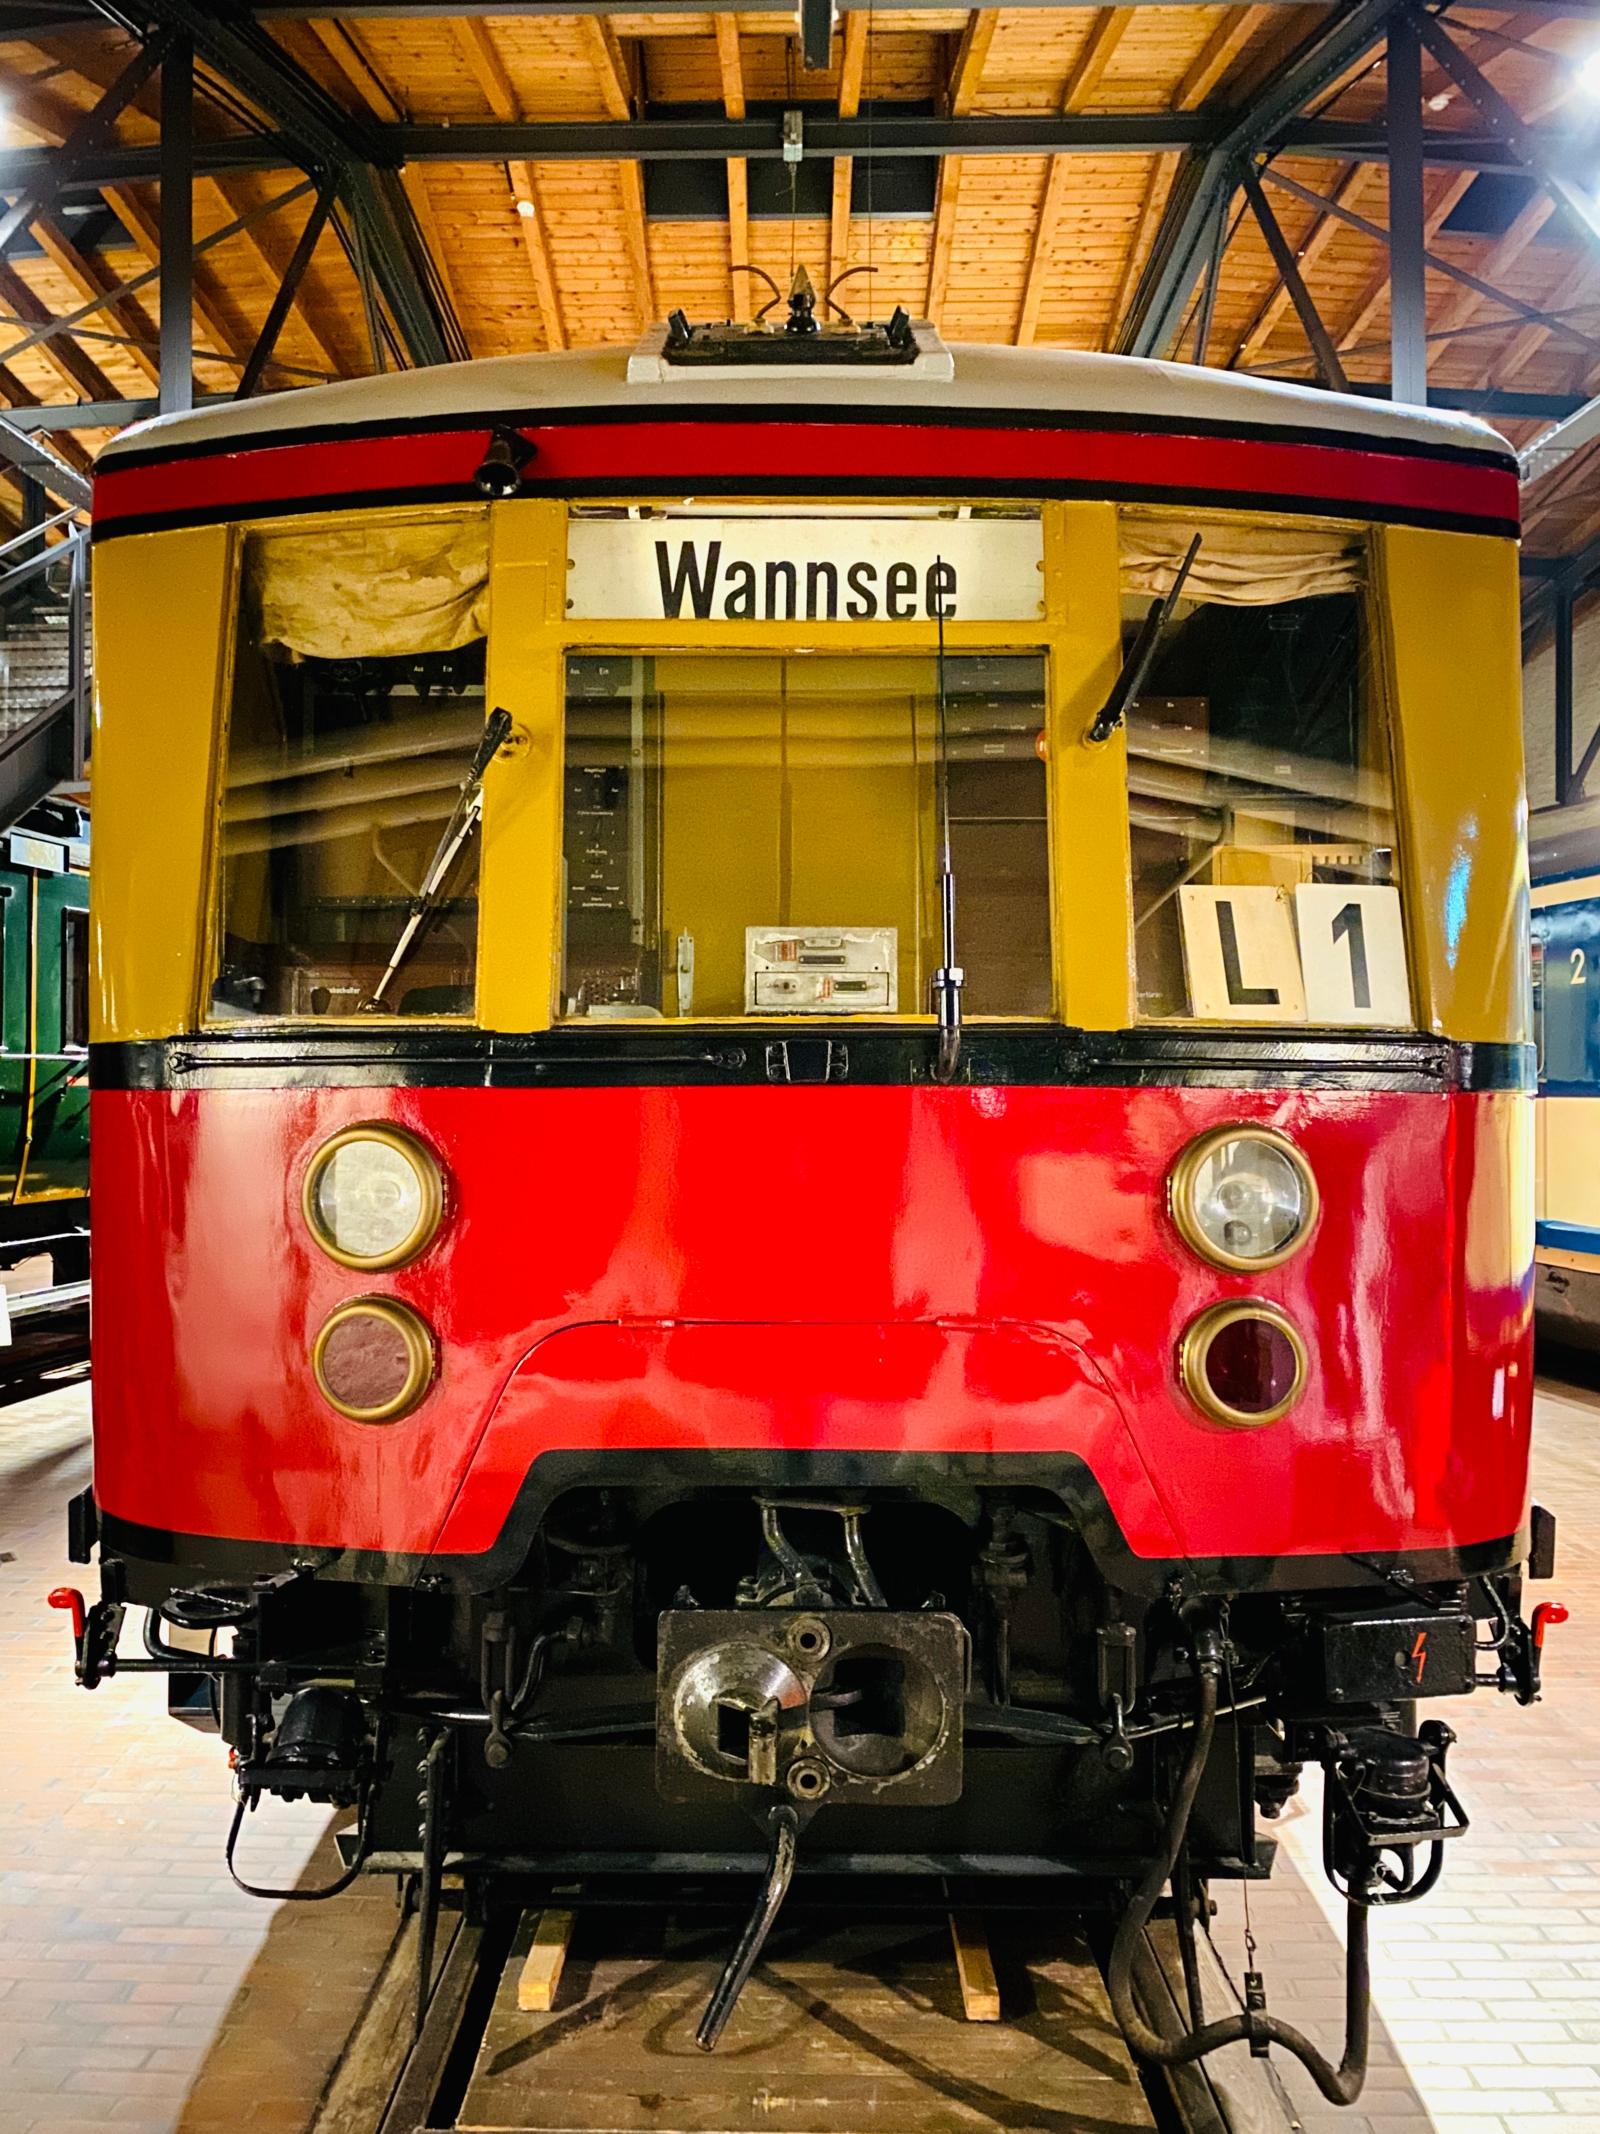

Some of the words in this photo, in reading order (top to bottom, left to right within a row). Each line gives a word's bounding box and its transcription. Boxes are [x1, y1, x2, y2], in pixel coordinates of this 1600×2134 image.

[655, 541, 957, 621] Wannsee
[1215, 900, 1281, 1006] L
[1331, 902, 1372, 1009] 1
[1570, 948, 1586, 985] 2
